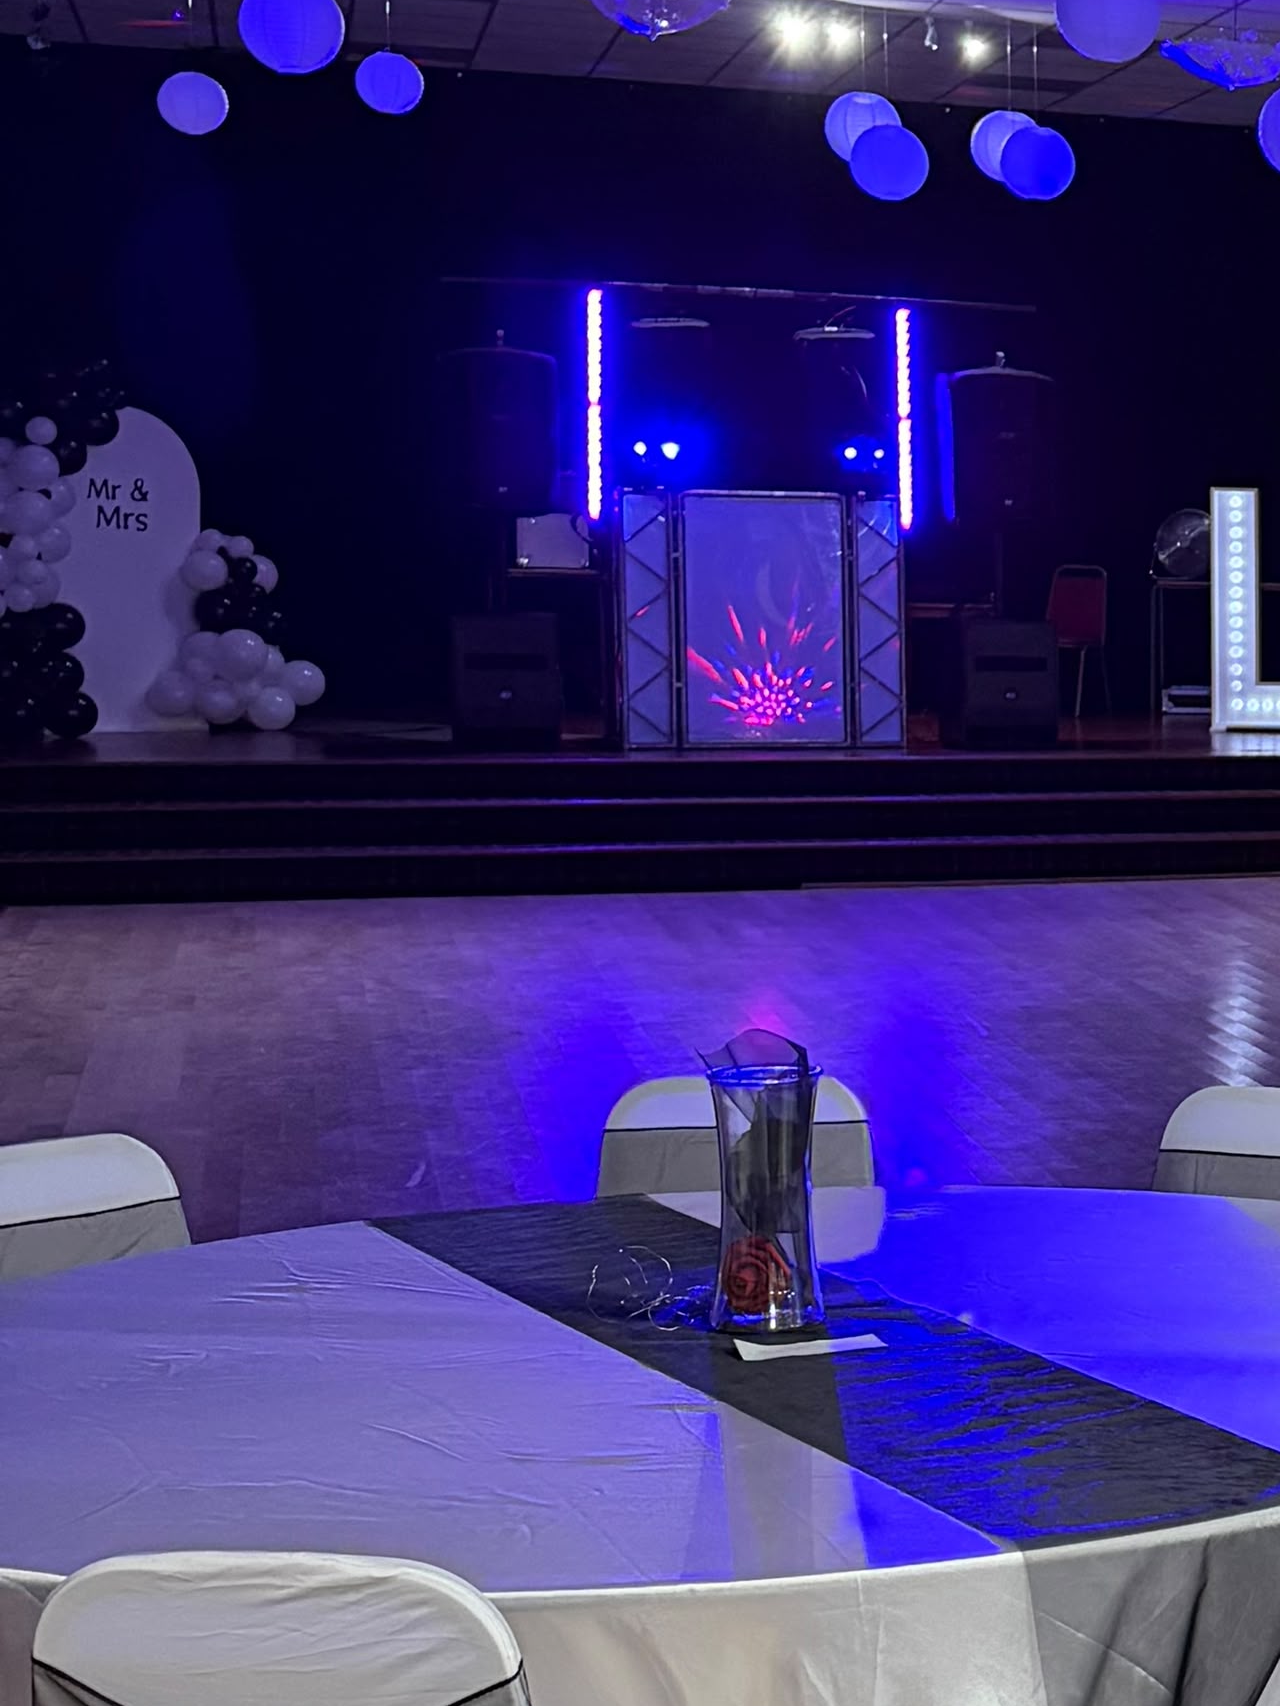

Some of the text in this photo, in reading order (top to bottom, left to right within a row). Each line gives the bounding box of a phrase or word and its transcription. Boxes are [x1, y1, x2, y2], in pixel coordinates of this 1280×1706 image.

[87, 478, 149, 501] Mr &
[96, 505, 148, 532] Mrs
